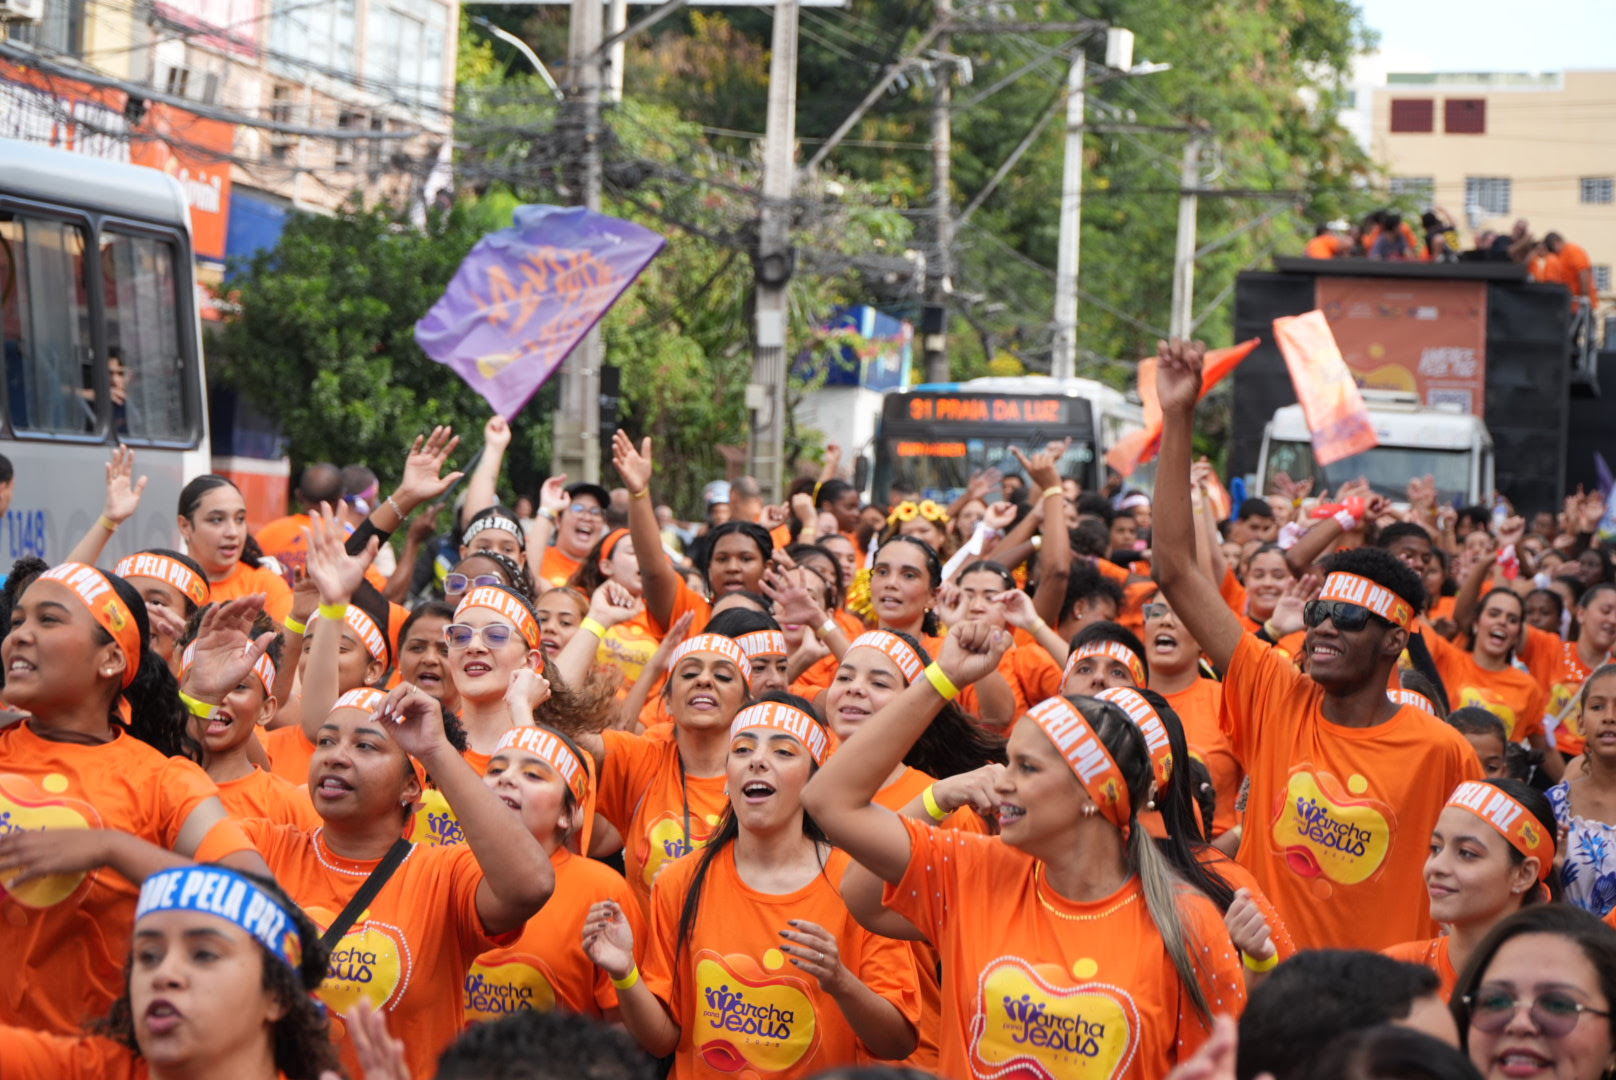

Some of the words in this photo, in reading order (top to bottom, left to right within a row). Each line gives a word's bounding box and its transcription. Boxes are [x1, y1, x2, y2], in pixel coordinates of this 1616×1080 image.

[993, 399, 1022, 421] DA
[66, 569, 110, 606] PAZ
[134, 554, 170, 582] PELA
[168, 566, 193, 592] PAZ
[471, 588, 505, 612] PELA
[505, 598, 528, 629] PAZ
[1330, 574, 1369, 603] PELA
[1365, 585, 1395, 617] PAZ
[365, 629, 386, 659] PAZ
[710, 635, 741, 662] PELA
[889, 640, 921, 679] PELA
[1108, 641, 1135, 666] PAZ
[1110, 688, 1153, 733] PELA
[773, 704, 811, 741] PELA
[806, 724, 828, 761] PAZ
[1038, 701, 1088, 752] PELA
[1067, 737, 1113, 785] PAZ
[518, 727, 558, 761] PELA
[554, 747, 579, 783] PAZ
[1297, 796, 1372, 843] Marcha
[1481, 791, 1524, 834] PAZ
[1298, 820, 1366, 858] Jesus
[178, 870, 248, 923] PELA
[242, 890, 287, 951] PAZ
[704, 984, 795, 1024] Marcha
[710, 1008, 791, 1040] Jesus
[1002, 994, 1106, 1039] Marcha
[1012, 1020, 1100, 1058] Jesus
